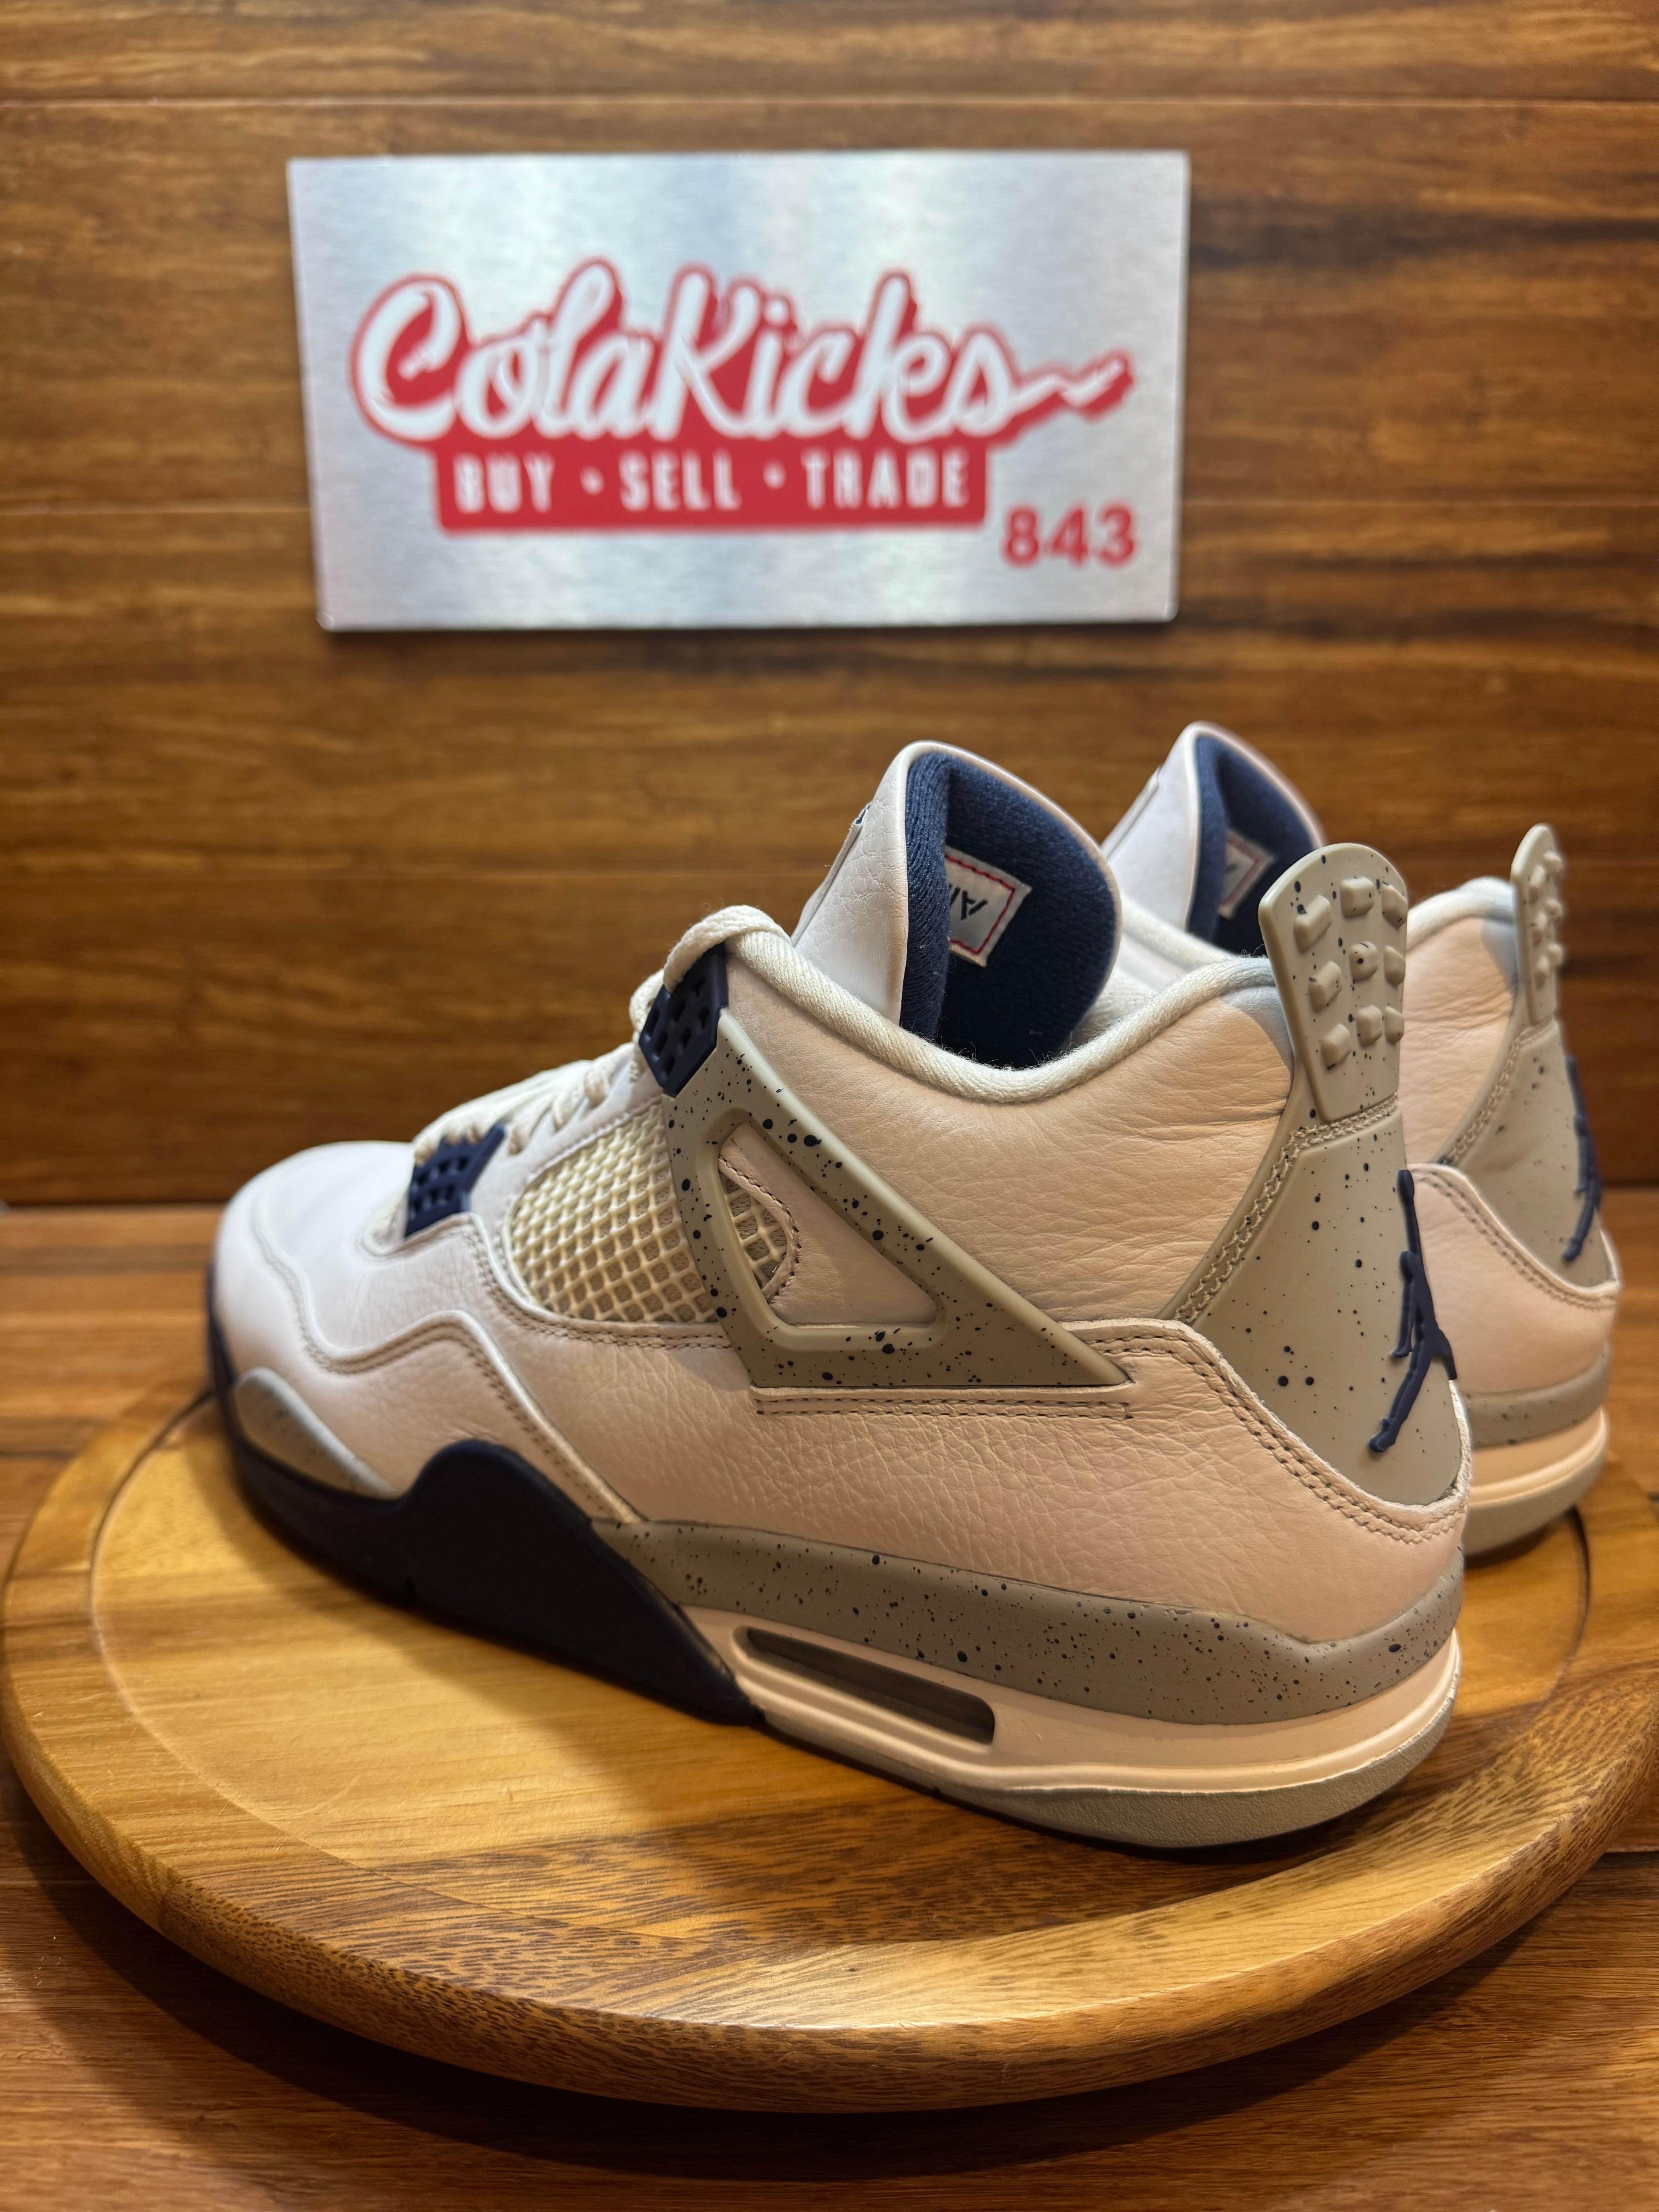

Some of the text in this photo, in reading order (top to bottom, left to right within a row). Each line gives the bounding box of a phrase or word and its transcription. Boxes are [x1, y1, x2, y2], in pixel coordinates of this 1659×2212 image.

[352, 257, 1134, 444] ColaKicks
[454, 447, 969, 513] BUY SELL TRADE
[1002, 501, 1137, 568] 843
